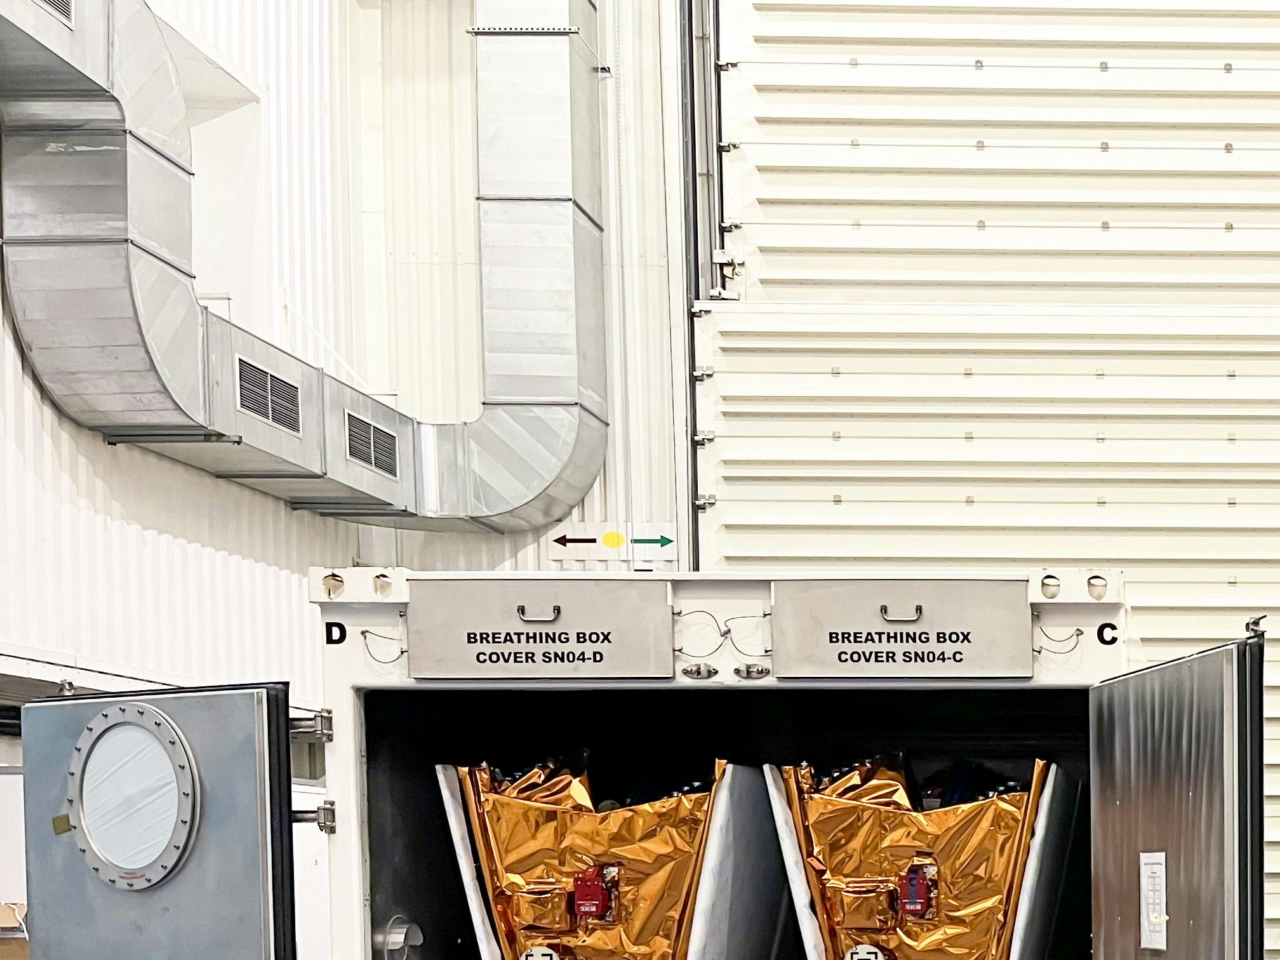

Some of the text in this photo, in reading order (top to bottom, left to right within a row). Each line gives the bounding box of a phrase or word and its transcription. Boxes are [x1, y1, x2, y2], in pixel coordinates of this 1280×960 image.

[326, 622, 346, 644] D
[467, 632, 612, 644] BREATHING BOX
[829, 632, 971, 643] BREATHING BOX
[1097, 623, 1118, 645] C
[476, 651, 603, 663] COVER SN04-D
[838, 651, 963, 662] COVER SN04-C
